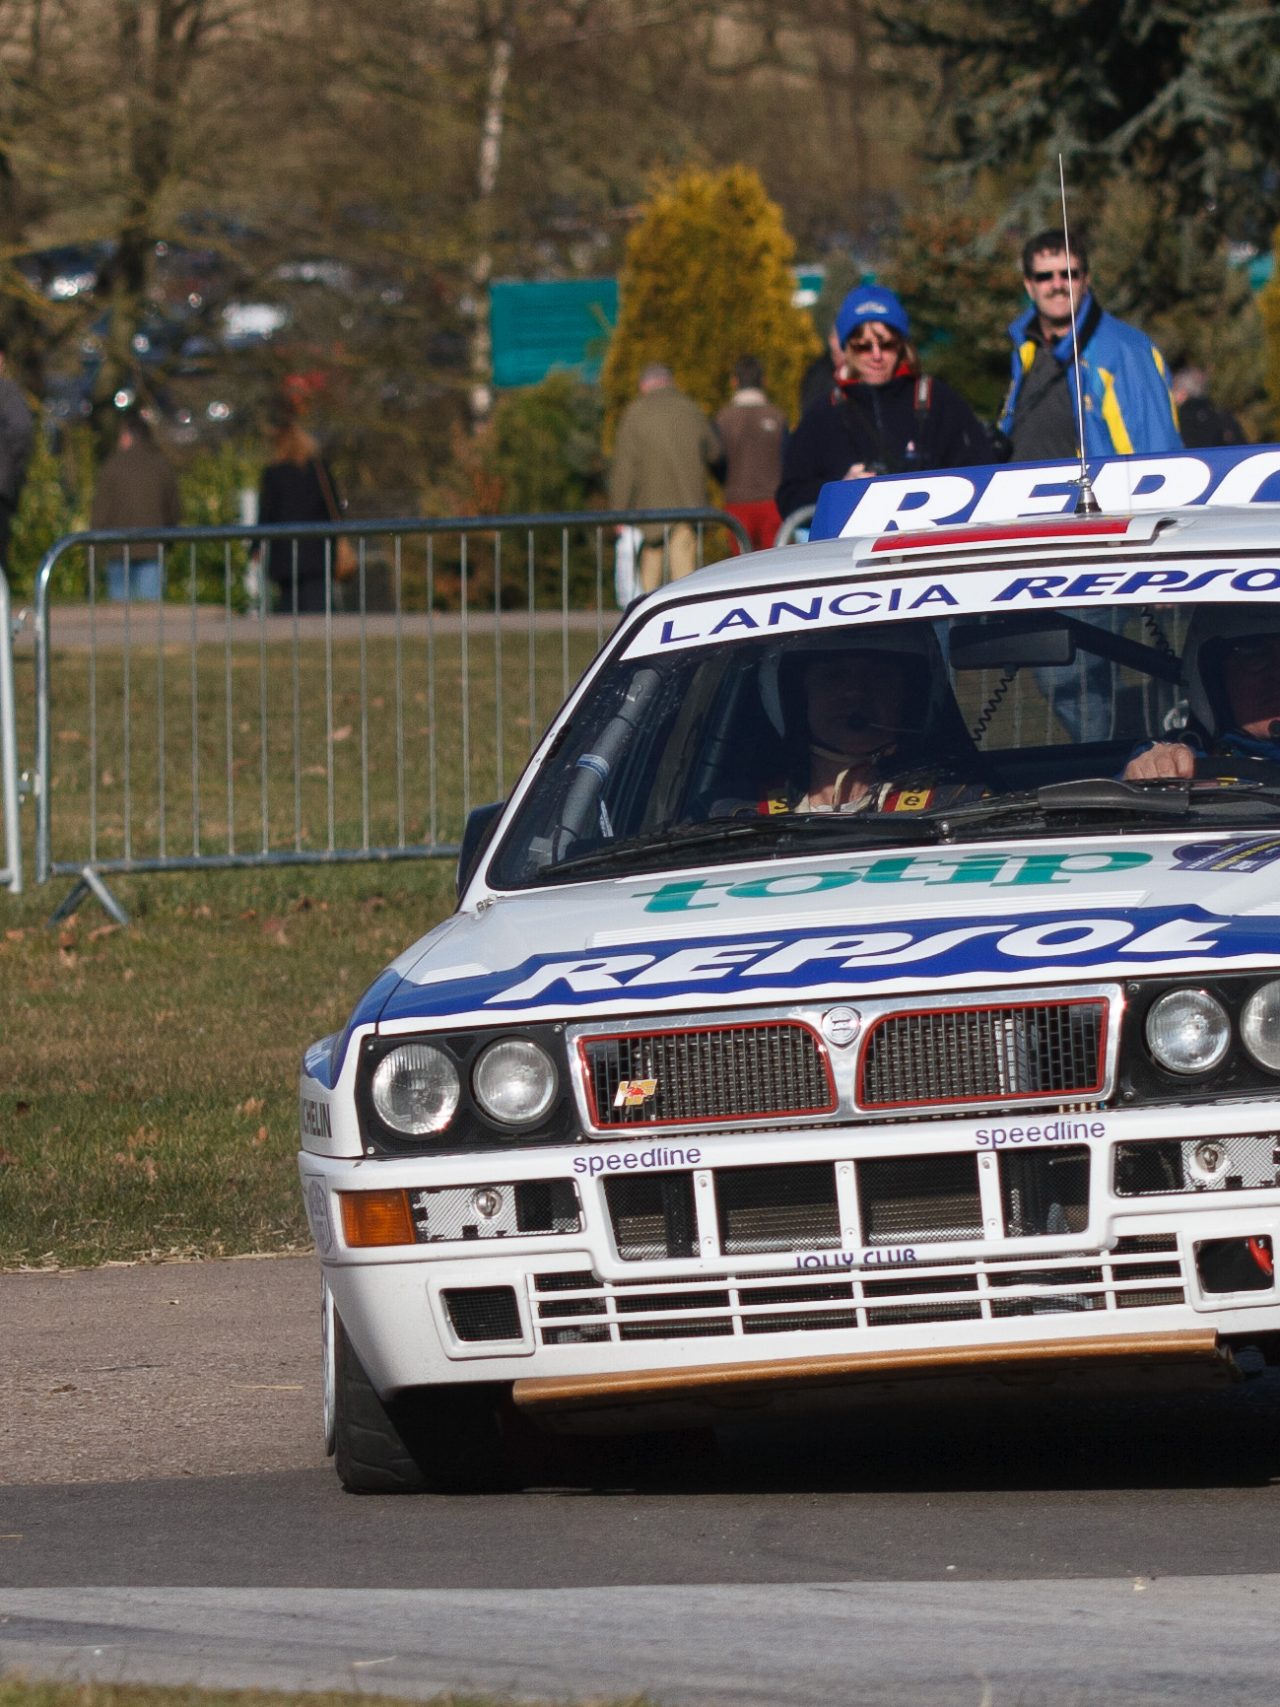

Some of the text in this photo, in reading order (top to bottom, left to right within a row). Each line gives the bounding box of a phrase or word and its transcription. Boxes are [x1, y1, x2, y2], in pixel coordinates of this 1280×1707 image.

[660, 583, 960, 645] LANCIA
[631, 852, 1154, 913] totip
[484, 918, 1232, 1005] REPSOL
[572, 1147, 701, 1177] speedline
[975, 1120, 1106, 1149] speedline
